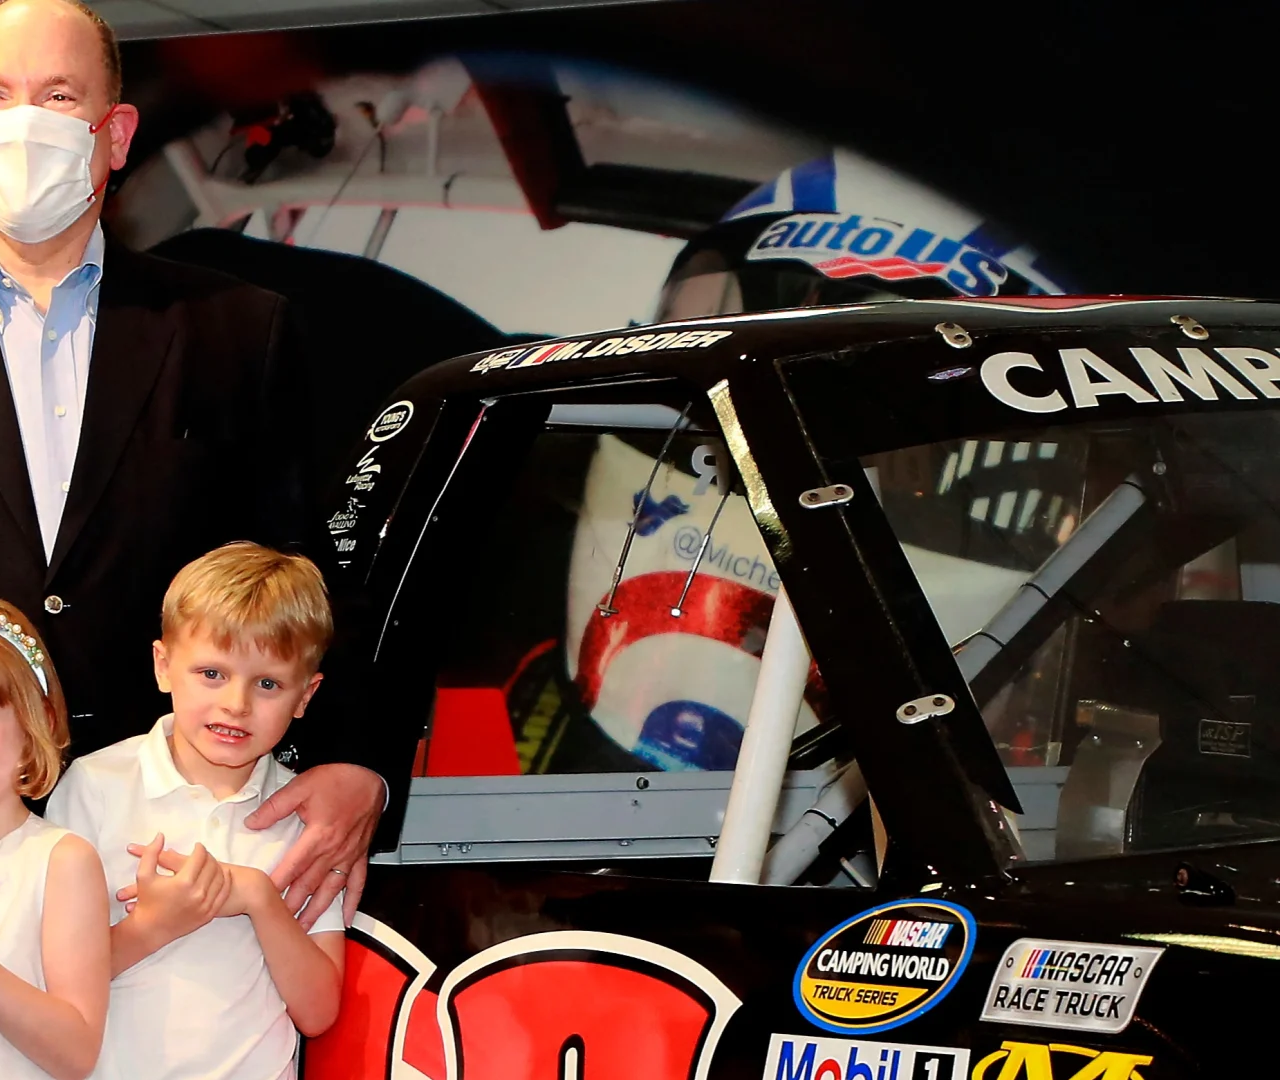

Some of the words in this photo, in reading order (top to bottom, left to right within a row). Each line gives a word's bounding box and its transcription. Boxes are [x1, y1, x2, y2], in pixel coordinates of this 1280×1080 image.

[583, 331, 734, 358] DISDIER
[887, 920, 950, 949] NASCAR
[817, 949, 891, 977] CAMPING
[891, 954, 950, 981] WORLD
[1040, 951, 1133, 986] NASCAR
[813, 985, 854, 1002] TRUCK
[854, 988, 899, 1006] SERIES
[993, 986, 1050, 1012] RACE
[1054, 991, 1126, 1019] TRUCK
